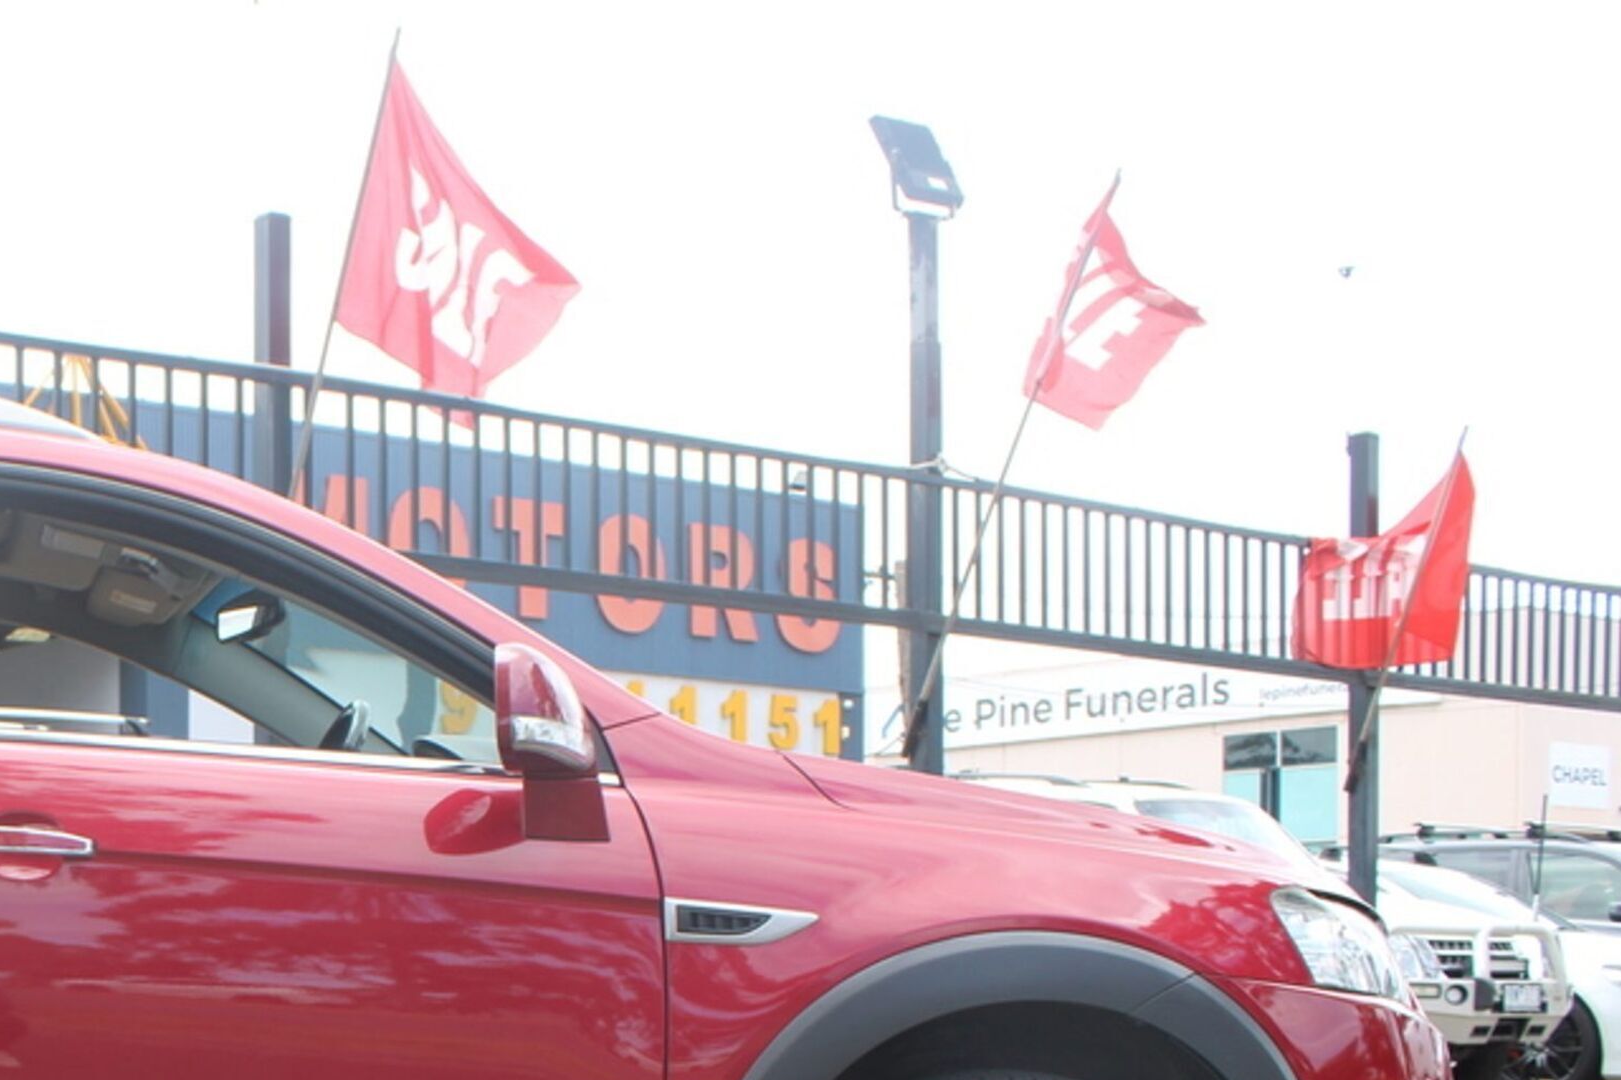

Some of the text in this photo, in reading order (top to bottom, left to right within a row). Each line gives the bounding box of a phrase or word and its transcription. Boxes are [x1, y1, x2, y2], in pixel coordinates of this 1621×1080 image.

[975, 695, 1054, 730] Pine
[1064, 672, 1231, 721] Funerals
[1552, 764, 1608, 787] CHAPEL
